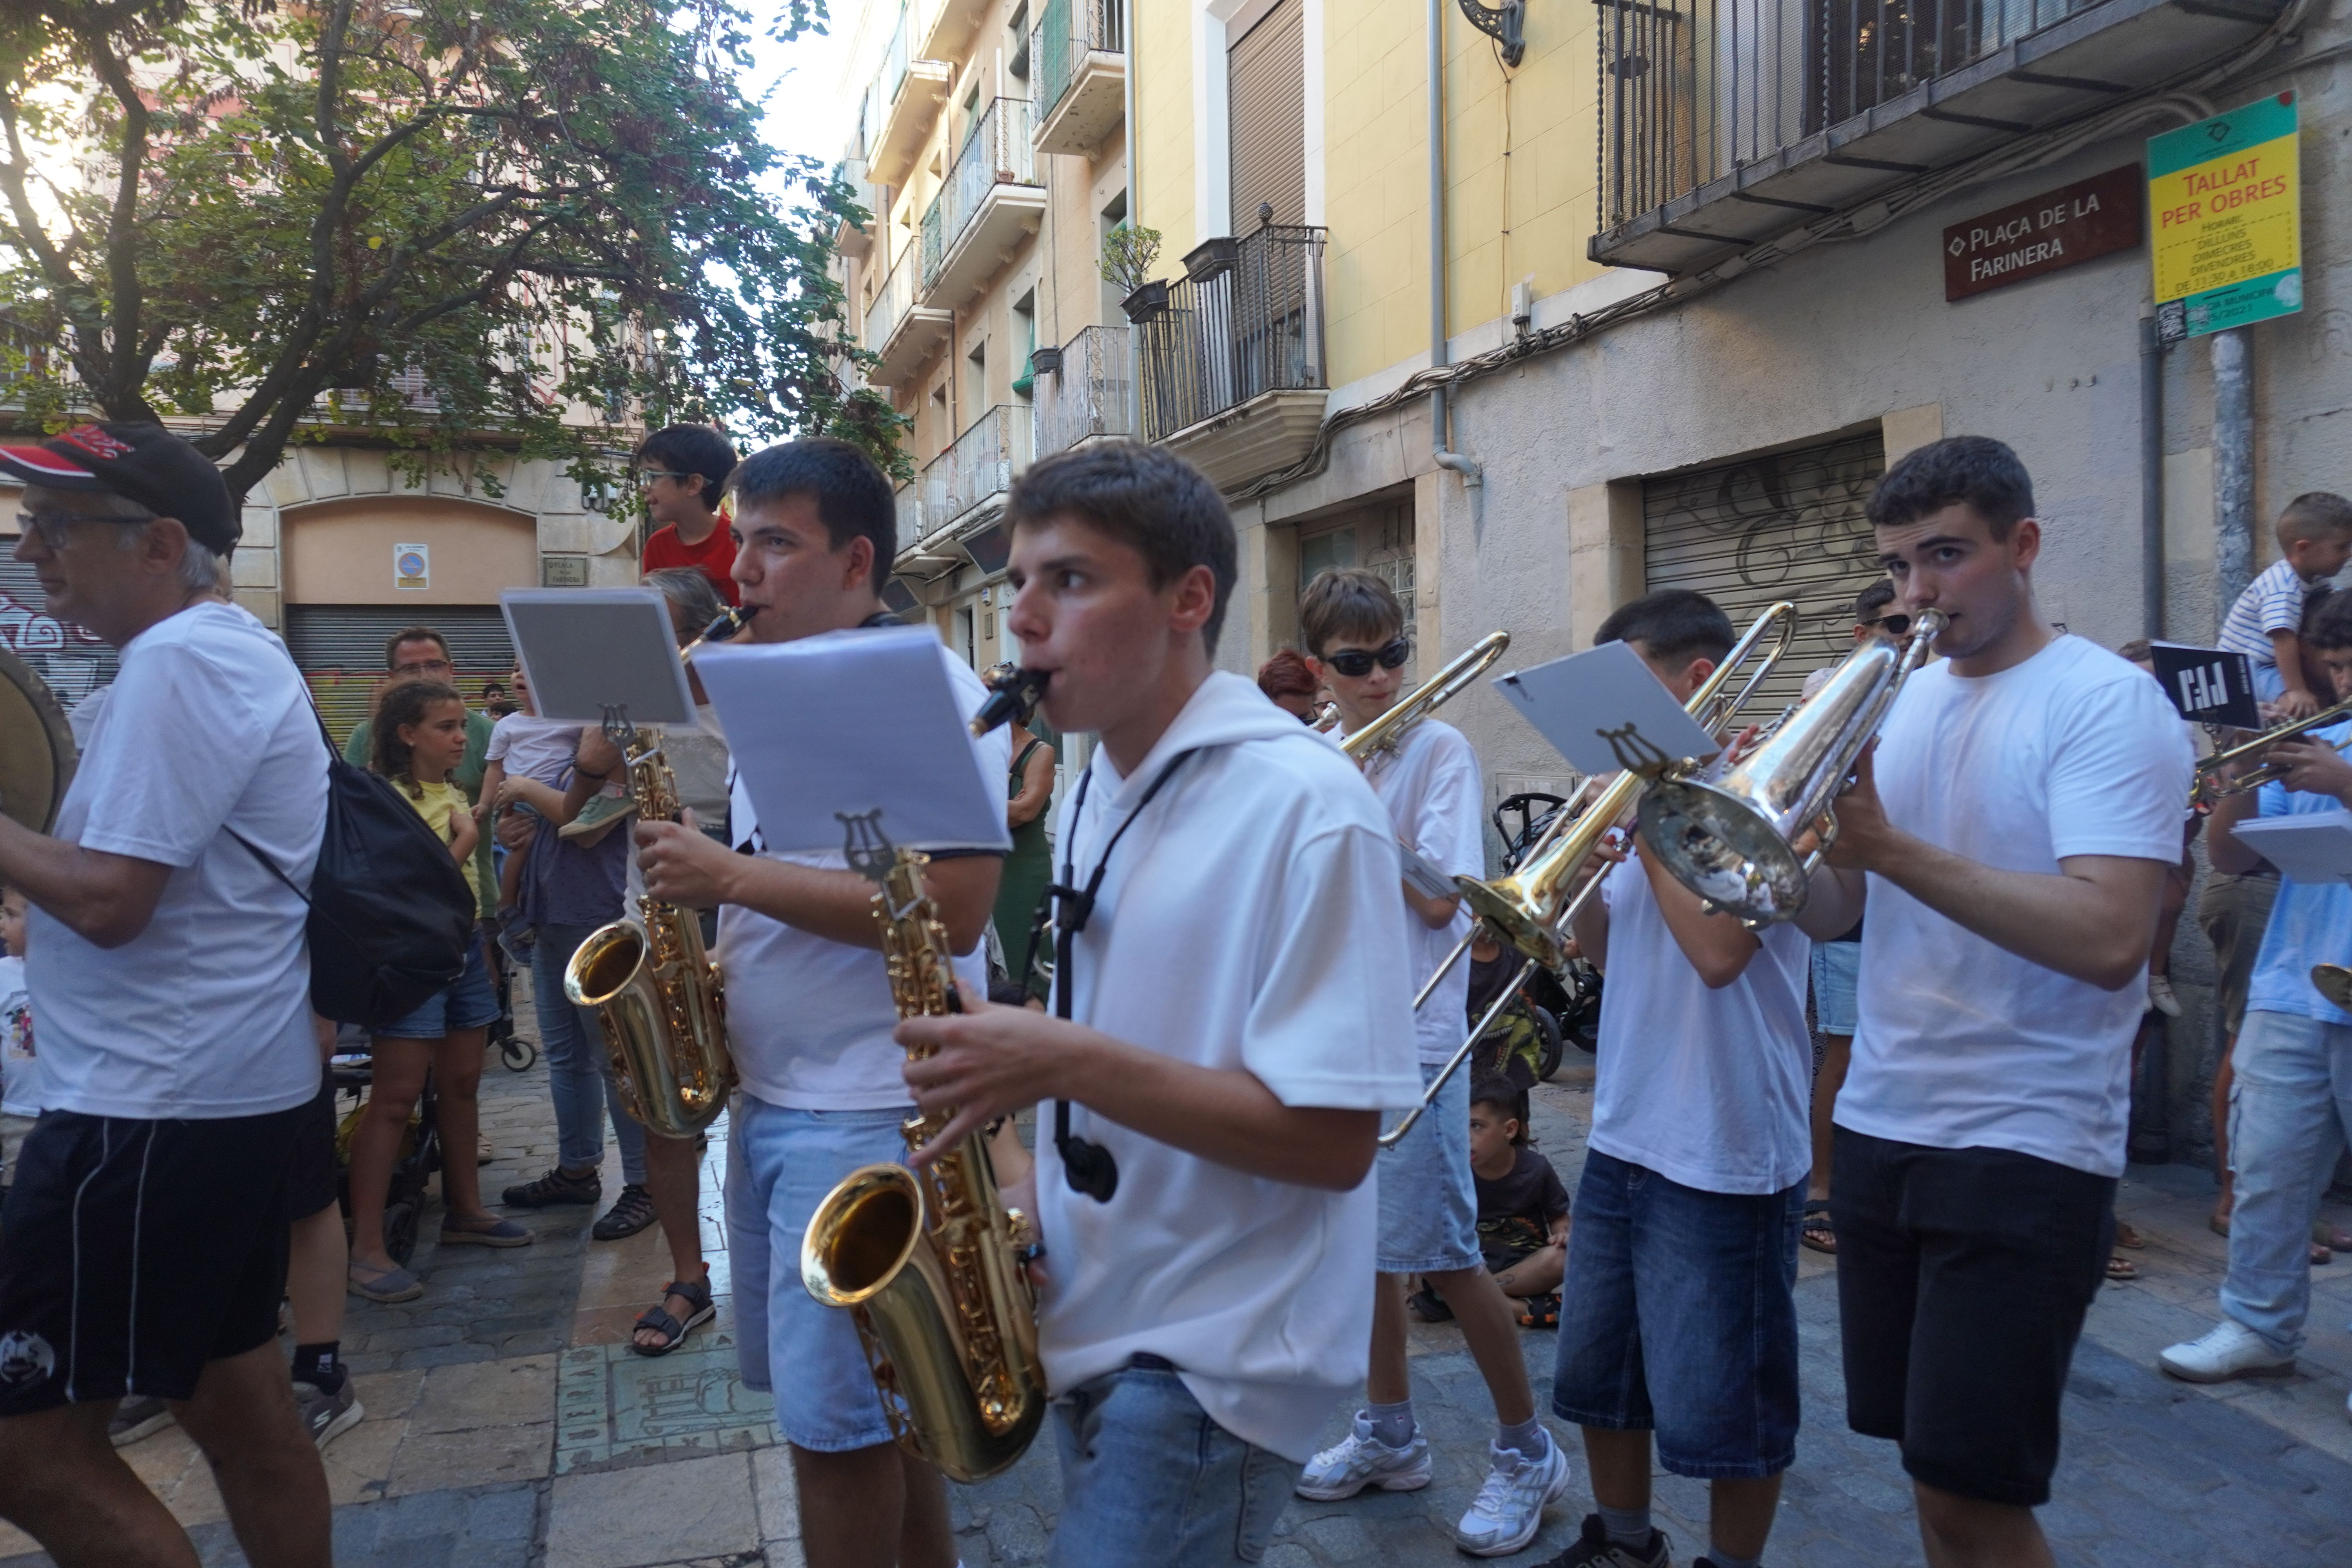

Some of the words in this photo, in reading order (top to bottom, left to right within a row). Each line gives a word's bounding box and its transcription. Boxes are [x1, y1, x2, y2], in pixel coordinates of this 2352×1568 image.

[2183, 158, 2260, 196] TALLAT
[2161, 201, 2202, 229] PER
[2211, 174, 2286, 213] OBRES
[1970, 216, 2032, 252] PLAÇA
[2039, 203, 2066, 230] DE
[2074, 194, 2100, 218] LA
[2198, 228, 2247, 250] DILLUNS
[1970, 238, 2064, 282] FARINERA
[2190, 250, 2256, 276] DIVENDRES
[2193, 239, 2252, 263] DIMECRES
[2176, 281, 2190, 292] DE
